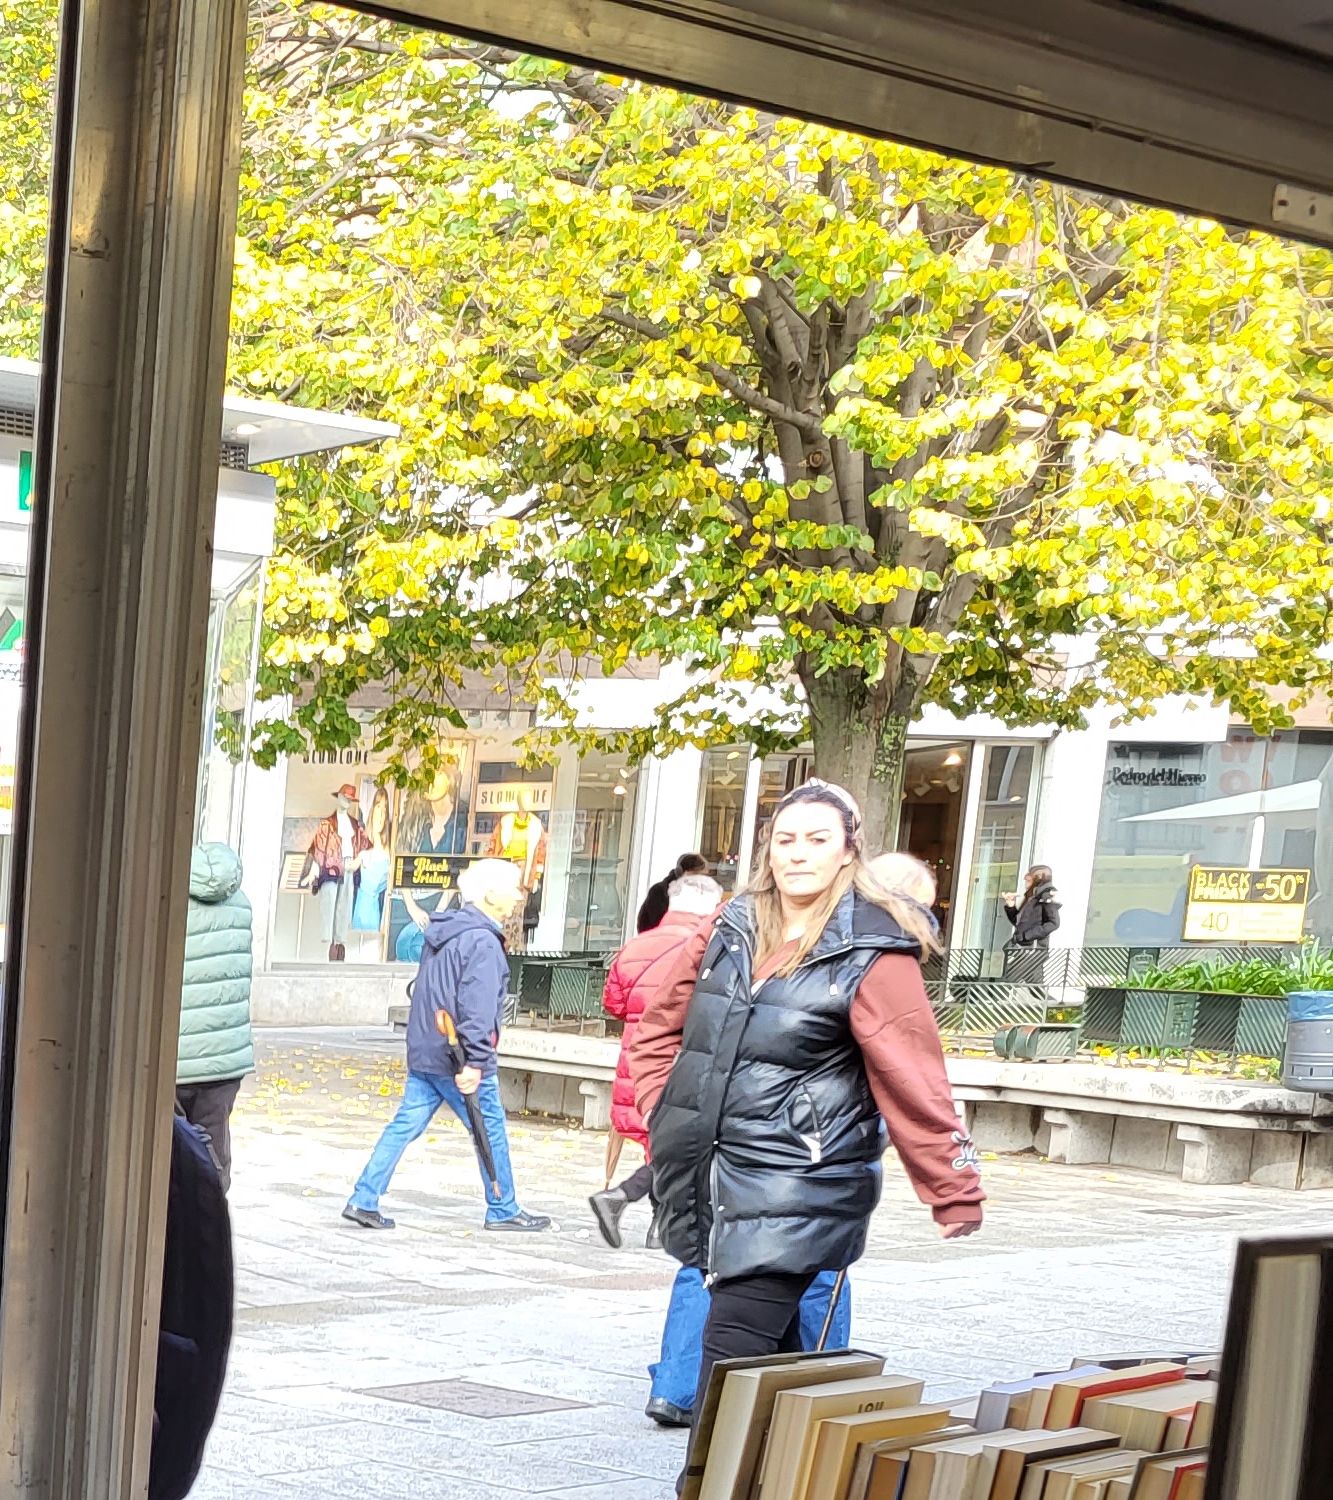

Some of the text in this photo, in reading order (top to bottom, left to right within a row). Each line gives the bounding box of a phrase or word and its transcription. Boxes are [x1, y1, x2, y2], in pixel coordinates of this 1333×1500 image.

[413, 856, 450, 873] Black
[412, 870, 452, 889] Friday
[1196, 872, 1251, 888] BLACK
